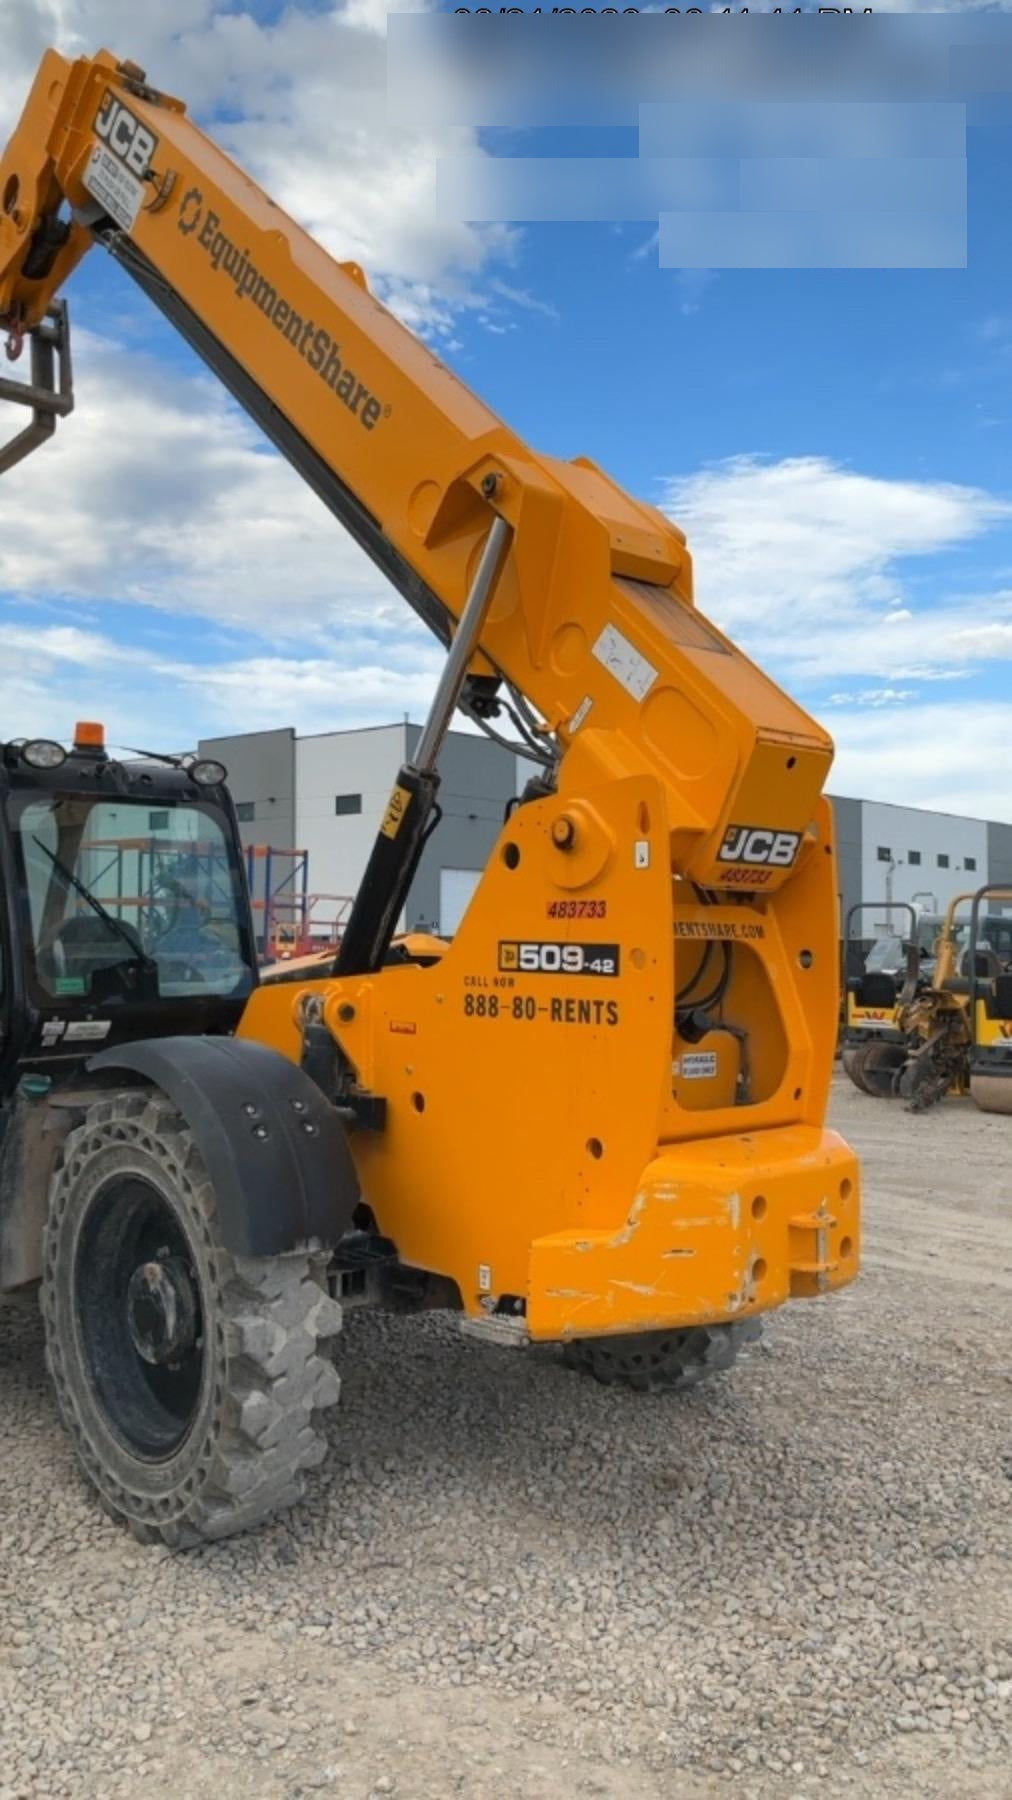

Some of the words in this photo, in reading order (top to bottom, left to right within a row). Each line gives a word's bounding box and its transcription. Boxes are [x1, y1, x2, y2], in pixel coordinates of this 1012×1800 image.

[95, 100, 156, 177] JCB
[198, 210, 381, 431] EquipmentShare
[719, 829, 799, 865] JCB
[548, 900, 606, 918] 483733
[464, 976, 489, 987] CALL
[493, 977, 515, 988] NOW
[464, 993, 619, 1026] 888-80-RENTS
